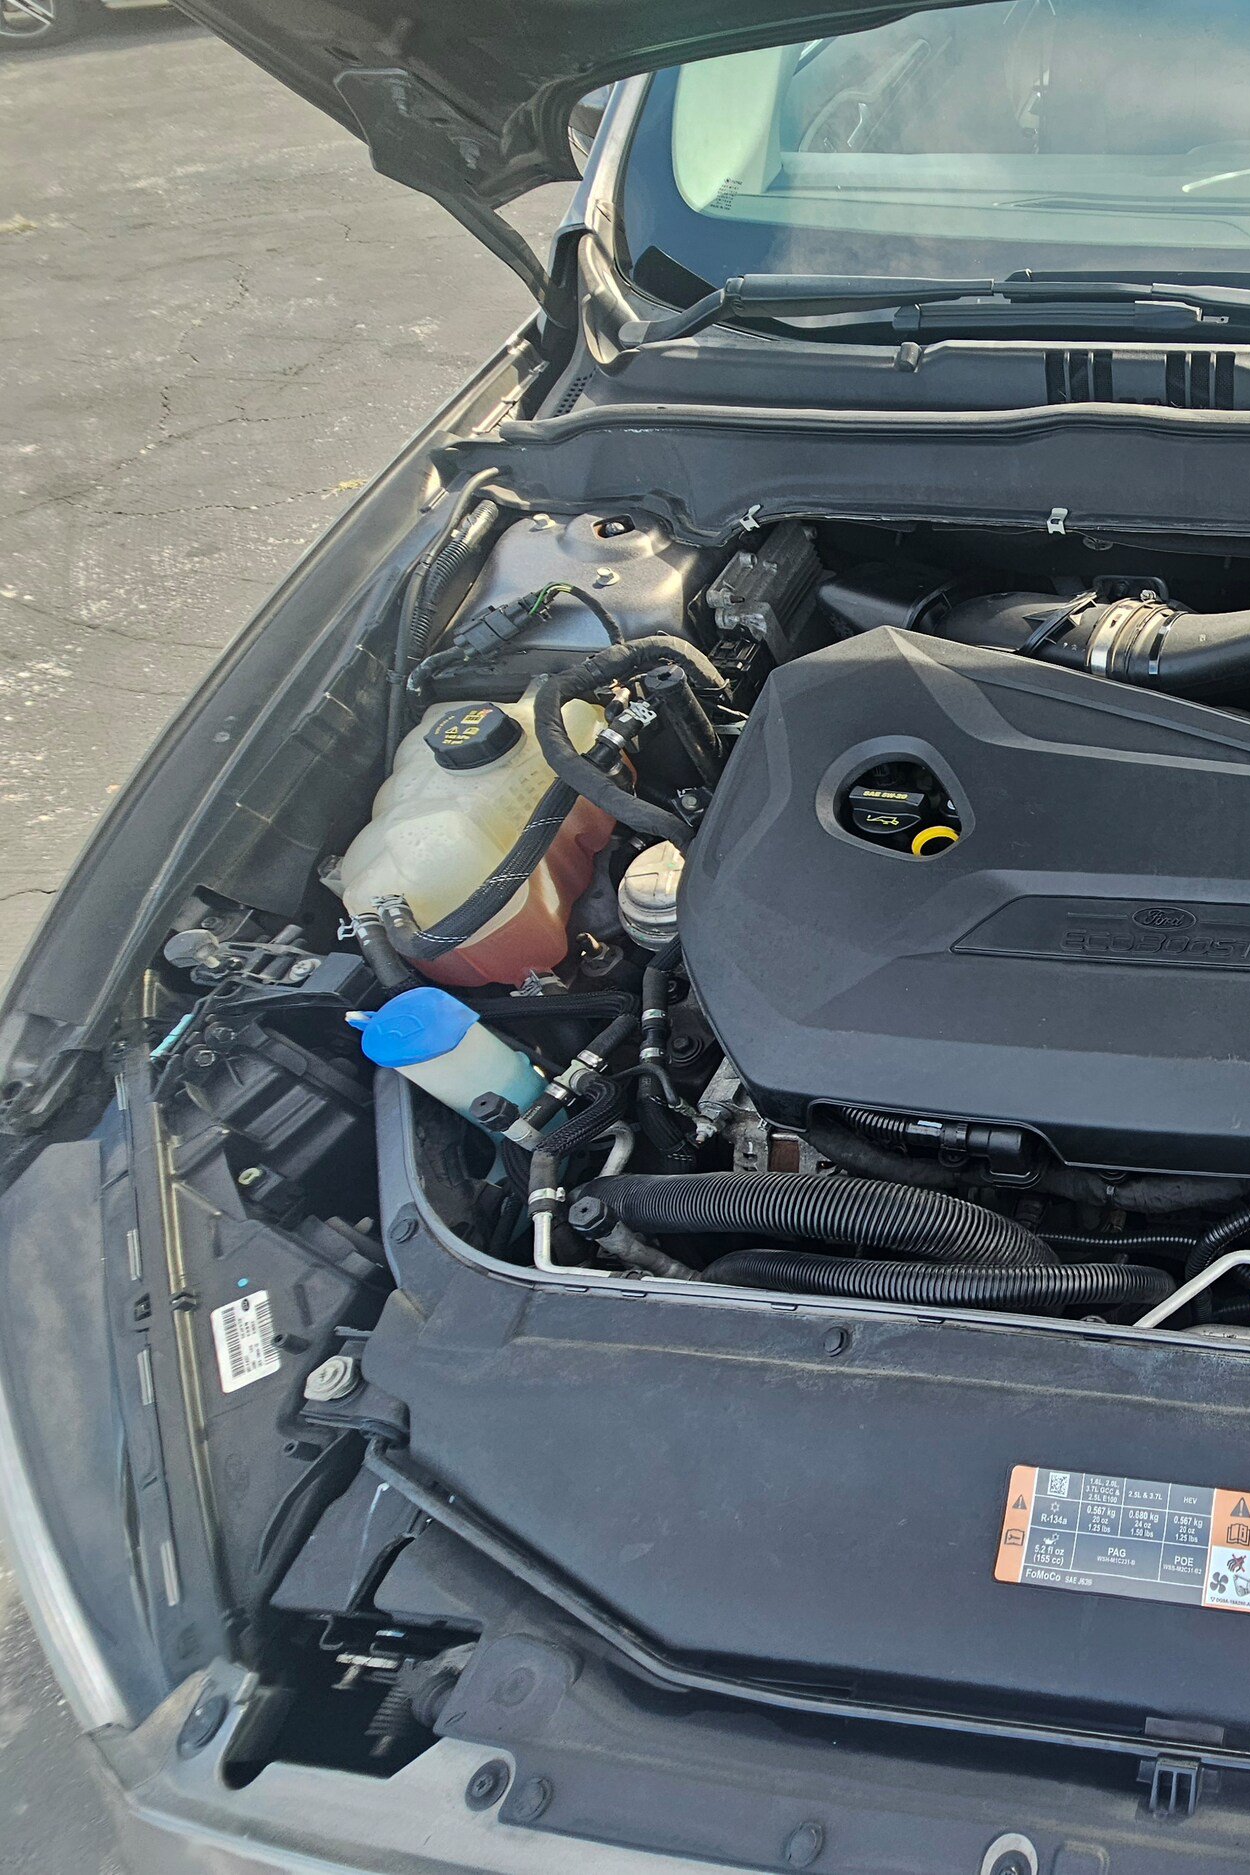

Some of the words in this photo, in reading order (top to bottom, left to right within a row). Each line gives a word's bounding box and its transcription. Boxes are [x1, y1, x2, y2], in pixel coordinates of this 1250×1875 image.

[1144, 908, 1184, 926] Ford
[1128, 1490, 1141, 1498] 2.5L
[1183, 1496, 1198, 1504] HEV
[1087, 1505, 1106, 1516] 0.567
[1107, 1508, 1116, 1519] kg
[1129, 1510, 1149, 1520] 0.680
[1150, 1512, 1159, 1523] kg
[1040, 1513, 1068, 1525] R-134a
[1174, 1516, 1193, 1525] 0.567
[1193, 1517, 1203, 1528] kg
[1088, 1524, 1100, 1532] 1.25
[1101, 1524, 1111, 1533] lbs
[1131, 1528, 1143, 1536] 1.50
[1144, 1529, 1154, 1538] lbs
[1175, 1534, 1188, 1542] 1.25
[1188, 1534, 1198, 1543] lbs
[1034, 1545, 1046, 1554] 5.2
[1048, 1546, 1054, 1554] fl
[1055, 1548, 1064, 1556] oz
[1107, 1547, 1127, 1558] PAG
[1033, 1553, 1050, 1563] (155
[1052, 1556, 1064, 1566] cc)
[1174, 1555, 1194, 1566] POE
[1025, 1568, 1061, 1581] FoMoCo
[1065, 1576, 1077, 1584] SAE
